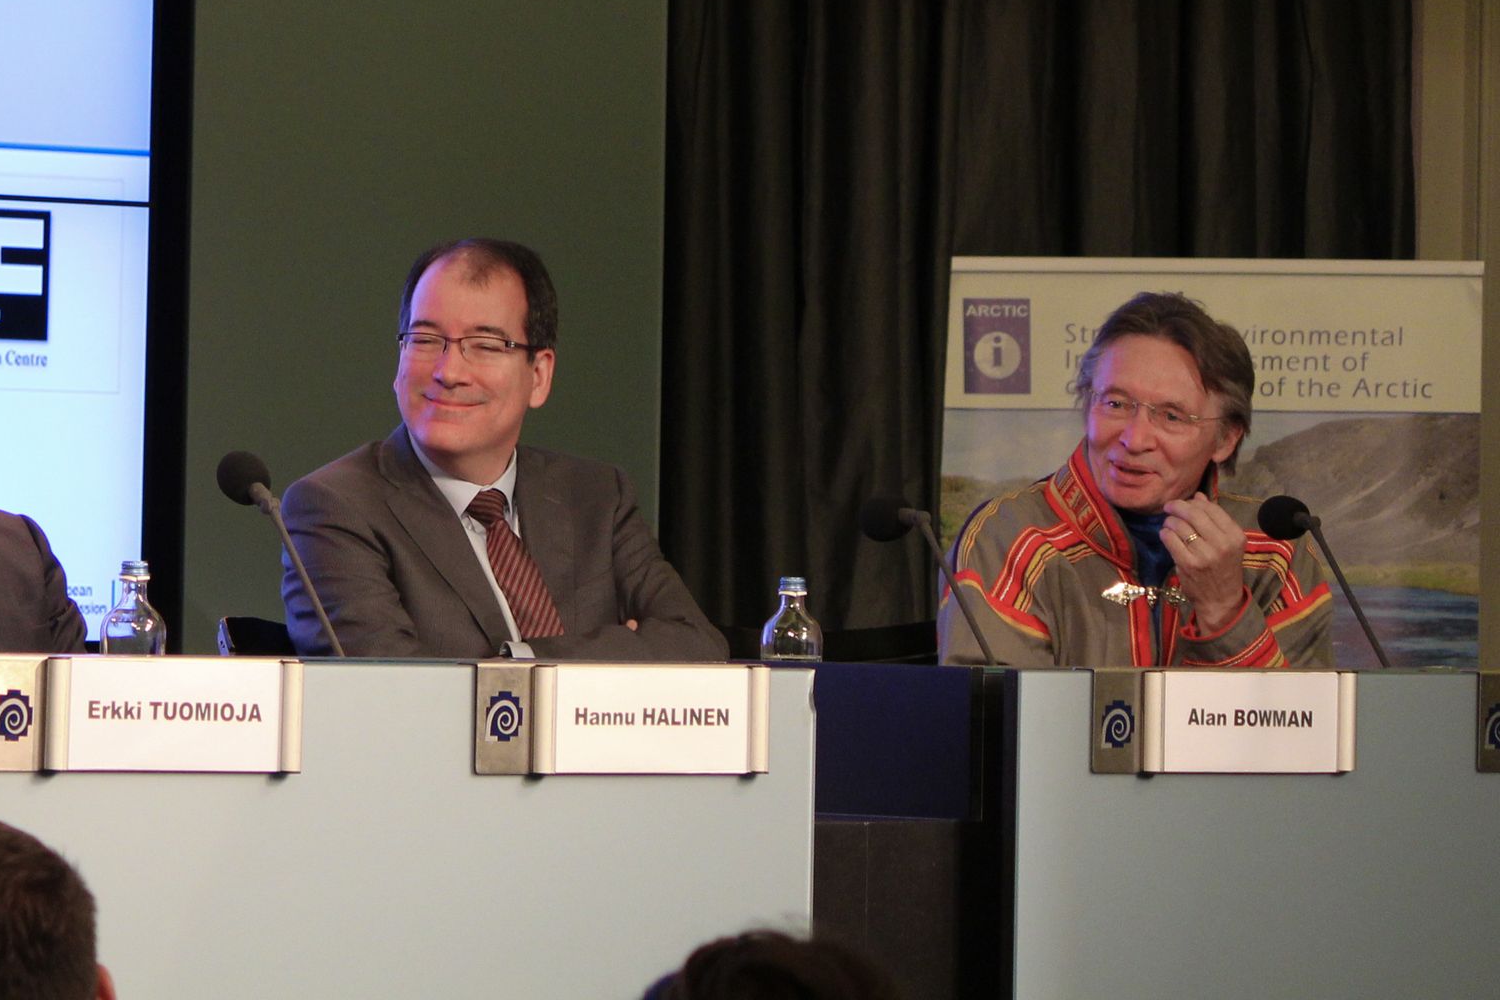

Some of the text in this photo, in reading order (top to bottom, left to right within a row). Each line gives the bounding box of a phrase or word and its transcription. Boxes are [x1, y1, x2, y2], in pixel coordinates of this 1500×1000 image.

[966, 304, 1028, 318] ARCTIC
[1241, 325, 1404, 347] vironmental
[5, 350, 48, 368] Centre
[1342, 352, 1370, 373] of
[1260, 377, 1434, 399] of the Arctic
[87, 700, 263, 723] Erkki TUOMIOJA
[574, 707, 730, 727] Hannu HALINEN
[1187, 707, 1314, 728] Alan BOWMAN
